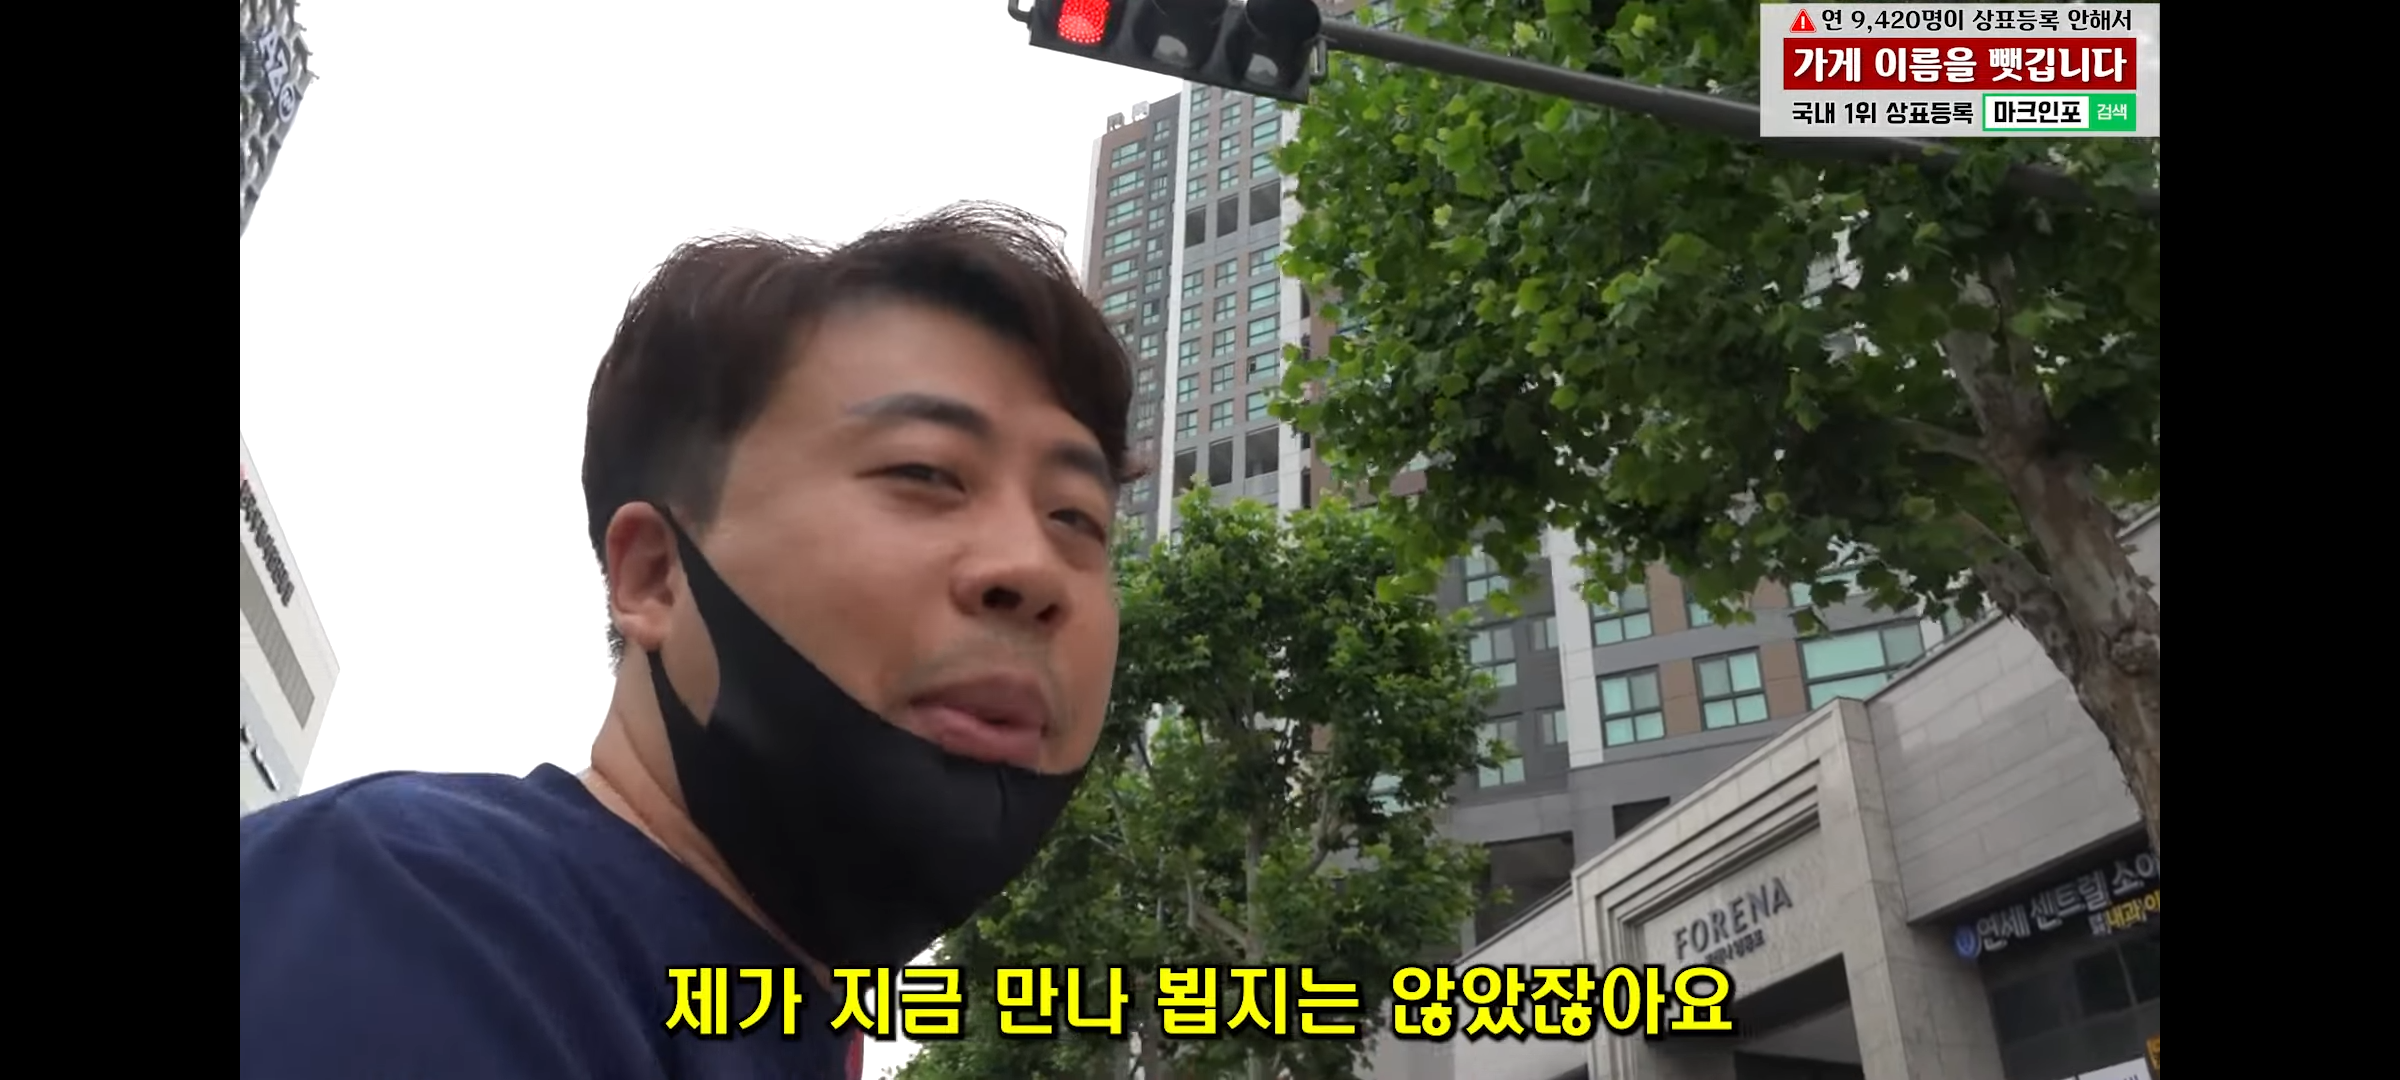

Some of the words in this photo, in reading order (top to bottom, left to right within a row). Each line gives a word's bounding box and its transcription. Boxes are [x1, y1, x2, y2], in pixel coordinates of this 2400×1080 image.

[1673, 876, 1793, 960] FORENA
[1977, 904, 2031, 951] 연세
[2031, 869, 2111, 931] 센트럴
